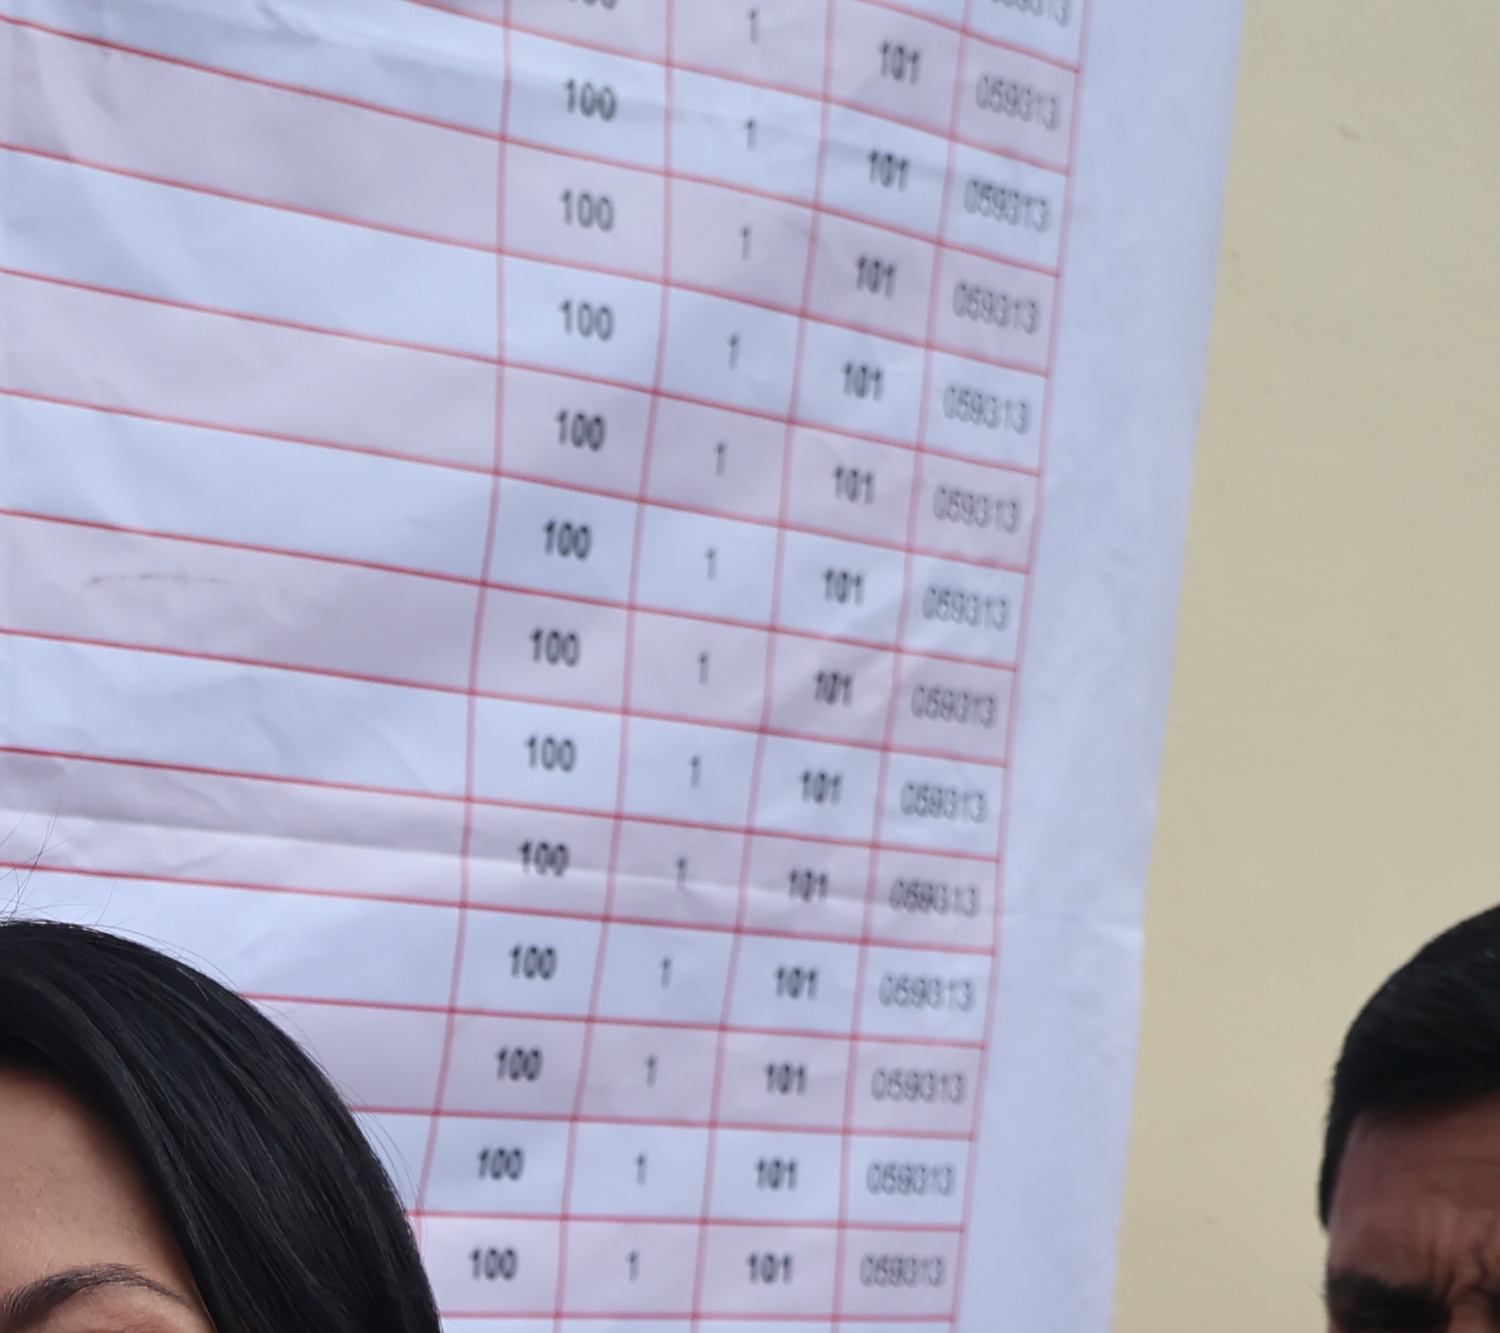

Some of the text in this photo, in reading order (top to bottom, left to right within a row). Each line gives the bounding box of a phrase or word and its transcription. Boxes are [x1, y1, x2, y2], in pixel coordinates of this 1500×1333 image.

[566, 79, 618, 121] 100
[744, 118, 758, 149] 1
[867, 149, 910, 188] 101
[544, 520, 591, 560] 100
[704, 547, 717, 580] 1
[824, 569, 863, 603] 101
[498, 1048, 542, 1081] 100
[645, 1054, 657, 1086] 1
[766, 1063, 806, 1094] 101
